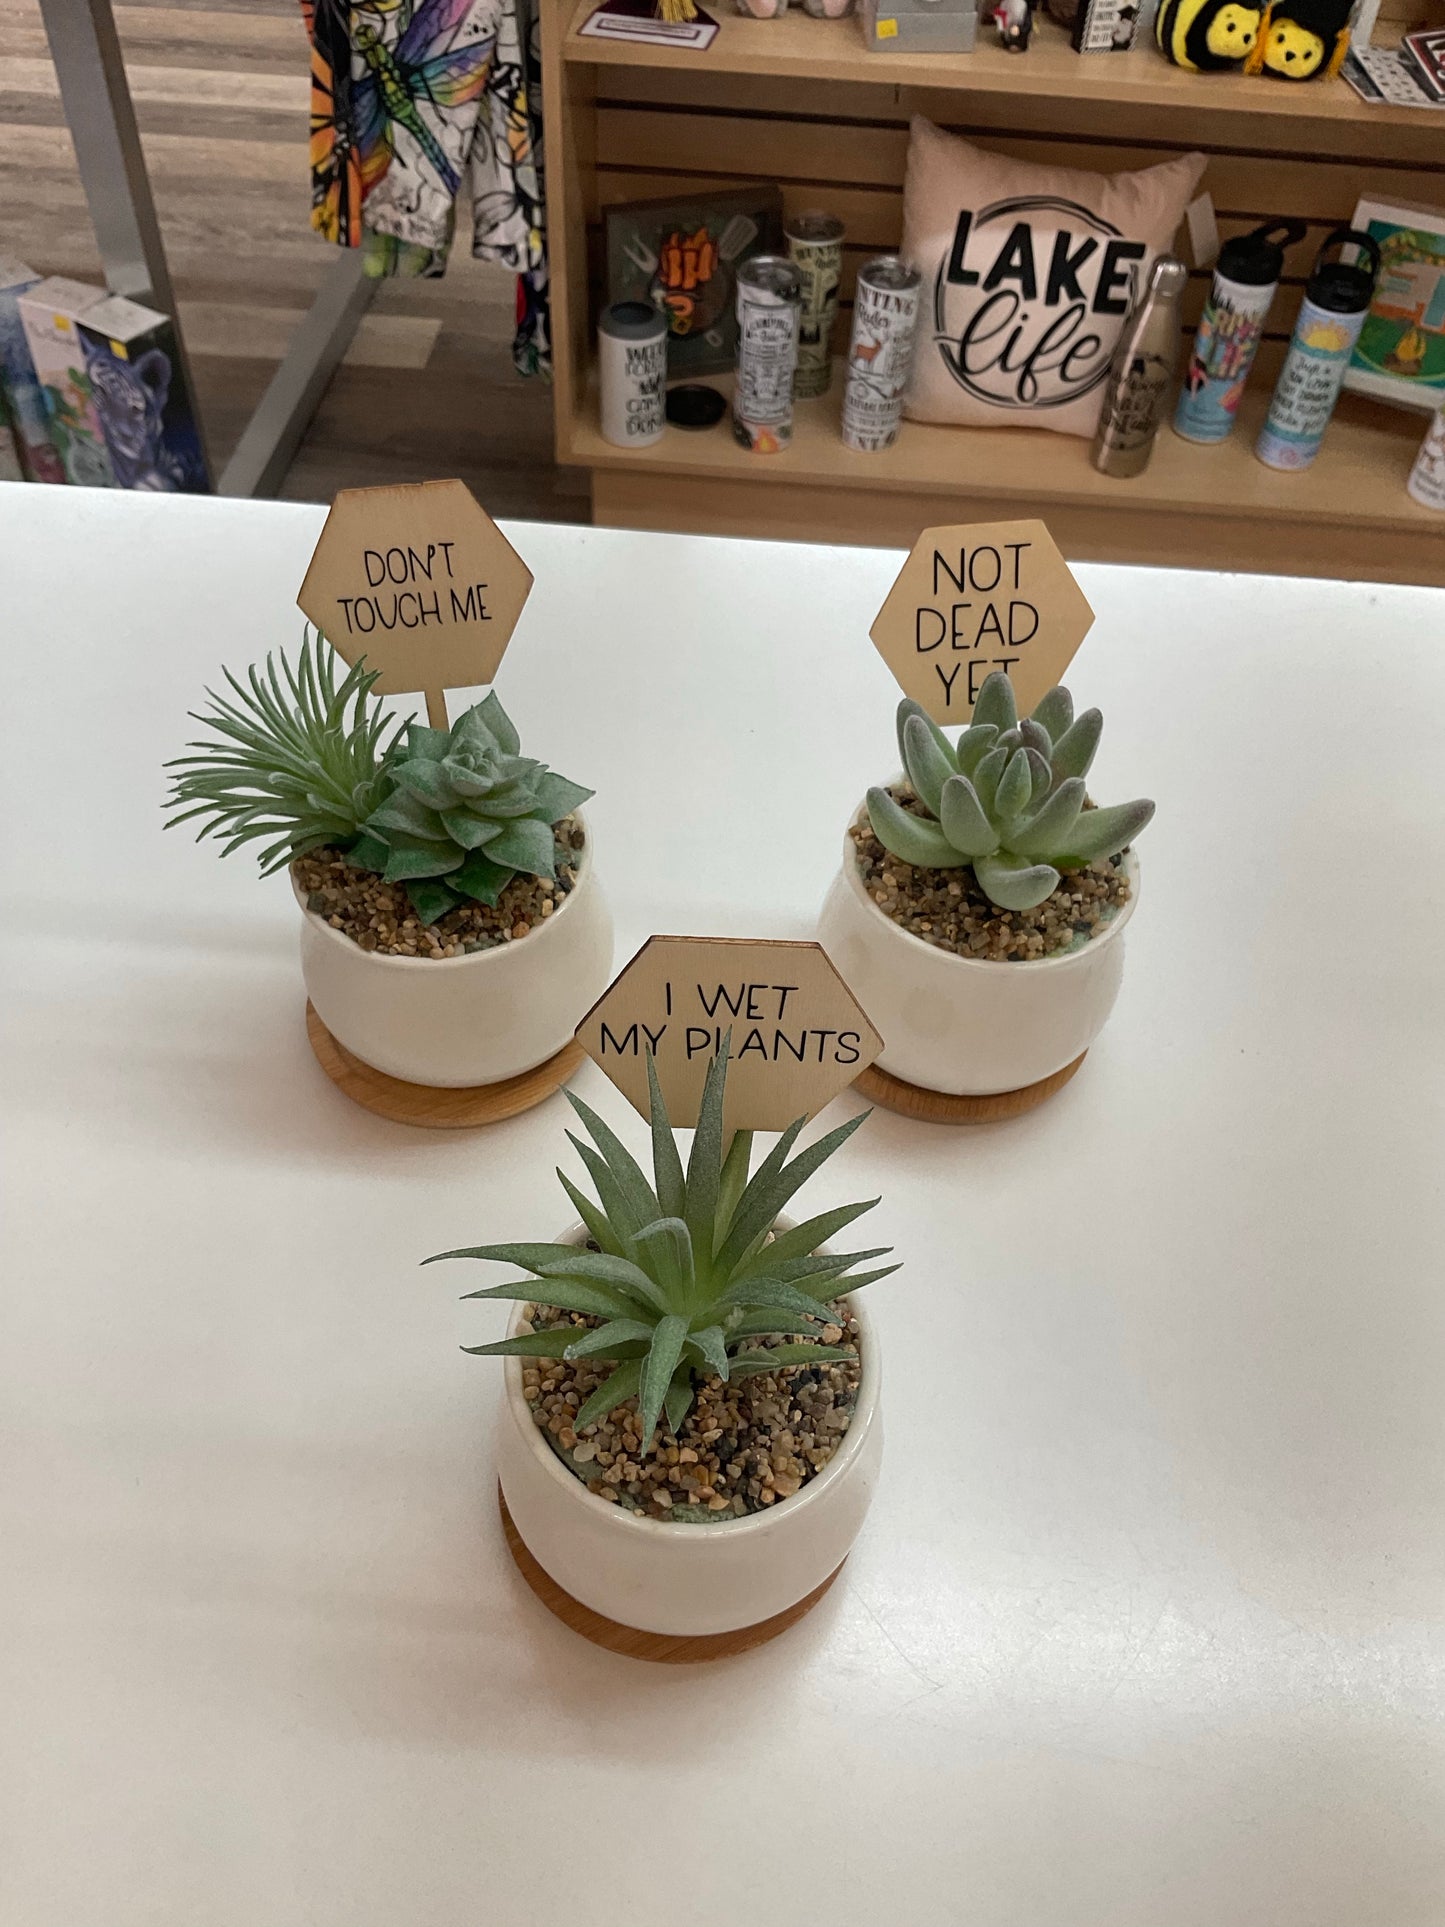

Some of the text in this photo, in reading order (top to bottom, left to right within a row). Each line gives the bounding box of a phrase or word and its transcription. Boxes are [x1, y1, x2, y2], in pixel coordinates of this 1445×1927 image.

[947, 209, 1146, 315] LAKE
[933, 289, 1101, 403] life
[364, 542, 455, 588] DON'T
[933, 543, 1032, 596] NOT
[336, 584, 493, 634] TOUCH ME
[916, 601, 1039, 653] DEAD
[665, 982, 799, 1020] I WET
[600, 1022, 860, 1064] MY PLANTS
